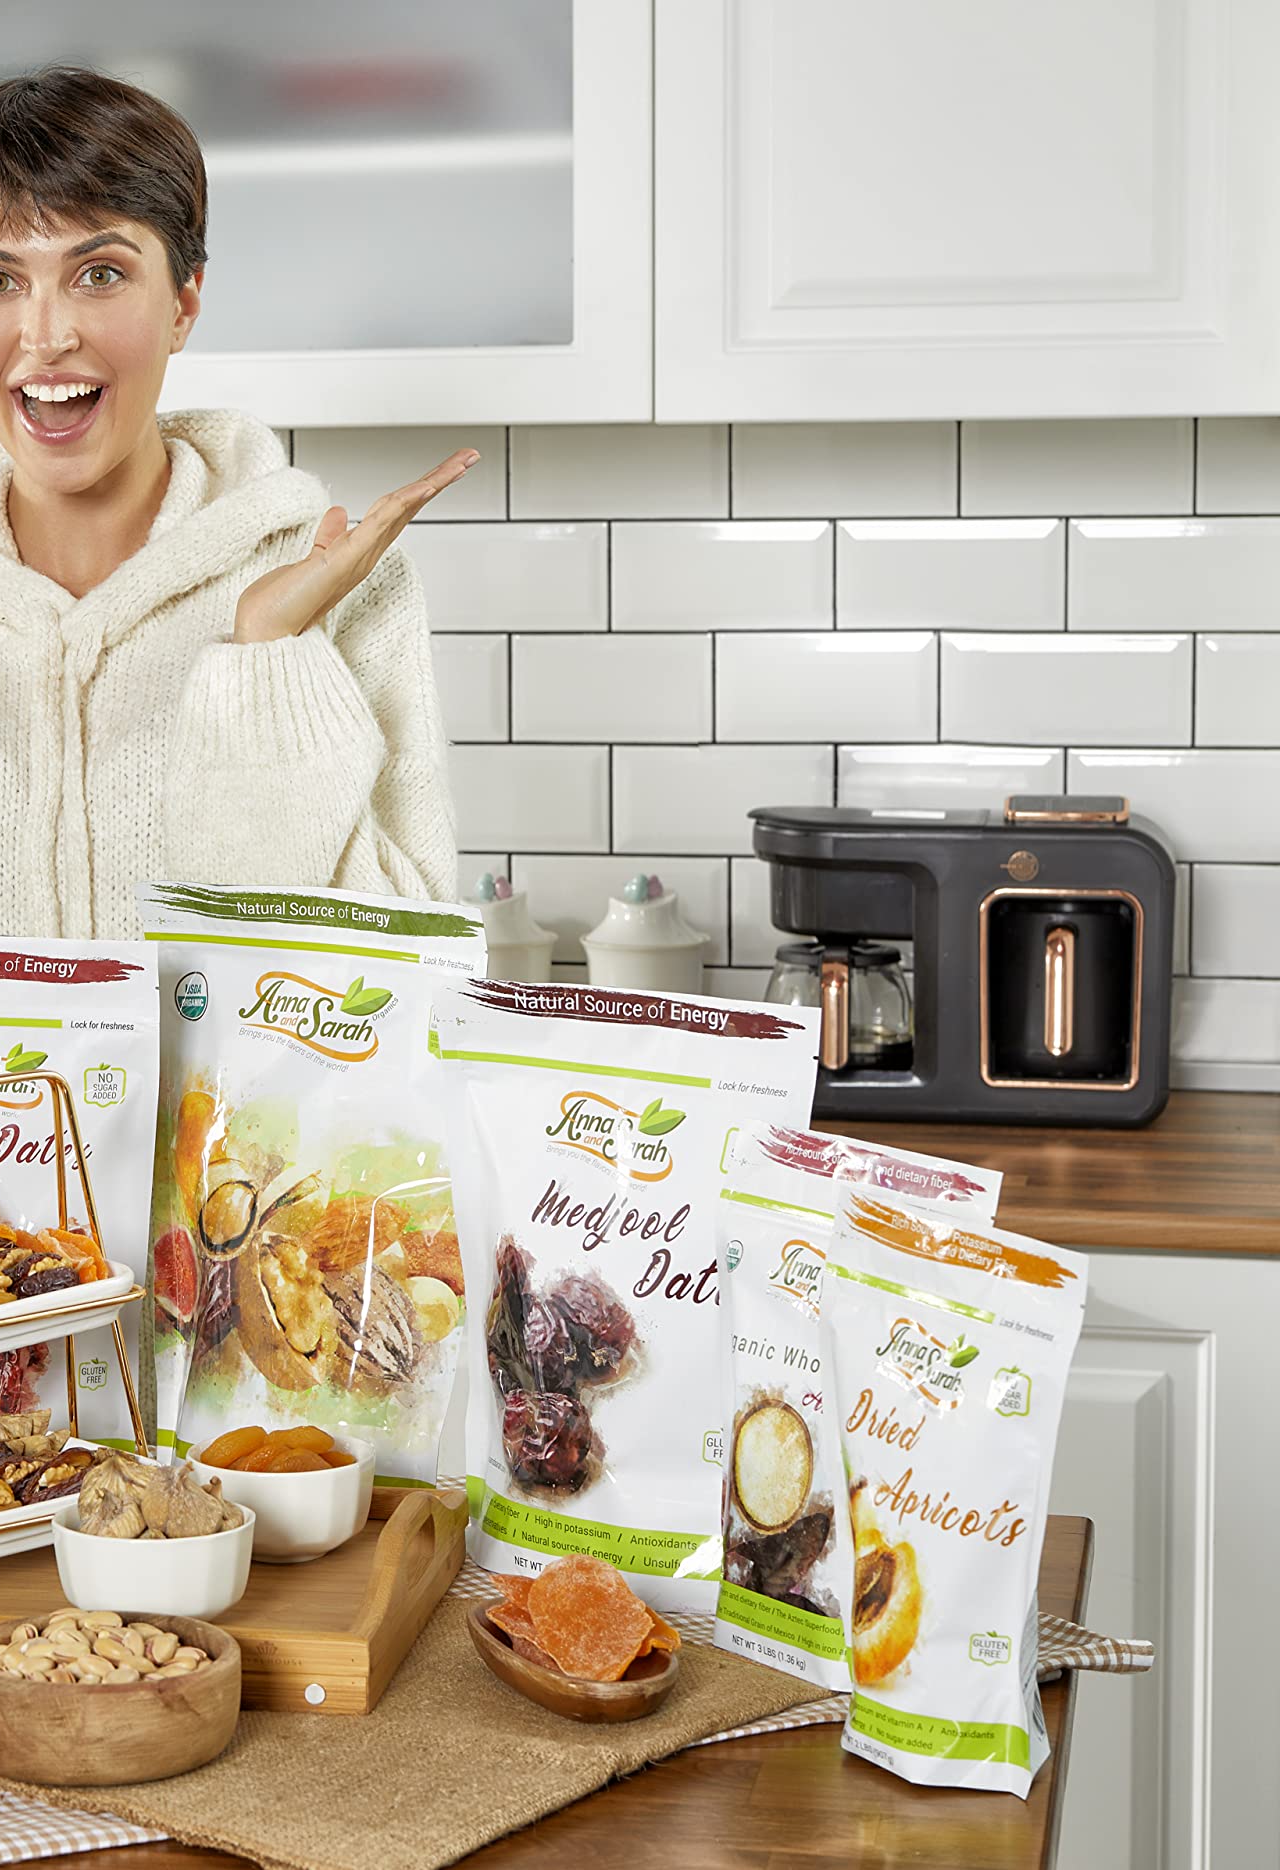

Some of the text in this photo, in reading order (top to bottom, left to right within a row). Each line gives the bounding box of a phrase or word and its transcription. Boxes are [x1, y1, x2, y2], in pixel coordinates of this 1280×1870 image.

[237, 902, 390, 927] Natural Source of Energy
[5, 957, 21, 971] of
[24, 958, 77, 976] Energy
[238, 980, 307, 1023] Anna
[372, 997, 398, 1021] Organics
[515, 992, 729, 1030] Natural Source of Energy
[71, 1021, 134, 1031] Lock for freshness
[280, 1016, 298, 1026] and
[297, 997, 373, 1042] Sarah
[239, 1027, 349, 1072] Brings you the flavors of the world!
[93, 1084, 117, 1092] SUGAR
[98, 1073, 113, 1082] NO
[93, 1091, 116, 1099] ADDED
[718, 1081, 787, 1097] Lock for freshness
[546, 1099, 614, 1141] Anna
[584, 1135, 604, 1146] and
[896, 1168, 953, 1191] dietary fiber
[531, 1180, 690, 1251] Medjool
[952, 1232, 1002, 1255] Potassium
[769, 1248, 821, 1285] Anna
[958, 1249, 992, 1269] Dietary
[633, 1249, 720, 1306] Dat
[732, 1334, 820, 1373] ganic Who
[81, 1366, 106, 1377] GLUTEN
[86, 1375, 102, 1384] FREE
[846, 1388, 925, 1451] Dried
[874, 1468, 1027, 1546] Apricots
[535, 1515, 697, 1551] High in potassium Antioxidants
[522, 1531, 623, 1564] Natural source of energy
[514, 1556, 543, 1571] NET WT
[805, 1620, 840, 1636] Superfood
[732, 1635, 806, 1671] NET WT 3 LBS (1.36 kg)
[822, 1644, 837, 1654] iron
[973, 1639, 1008, 1650] GLUTEN
[979, 1649, 1001, 1658] FREE
[940, 1727, 995, 1739] Antioxidants
[906, 1739, 933, 1750] added
